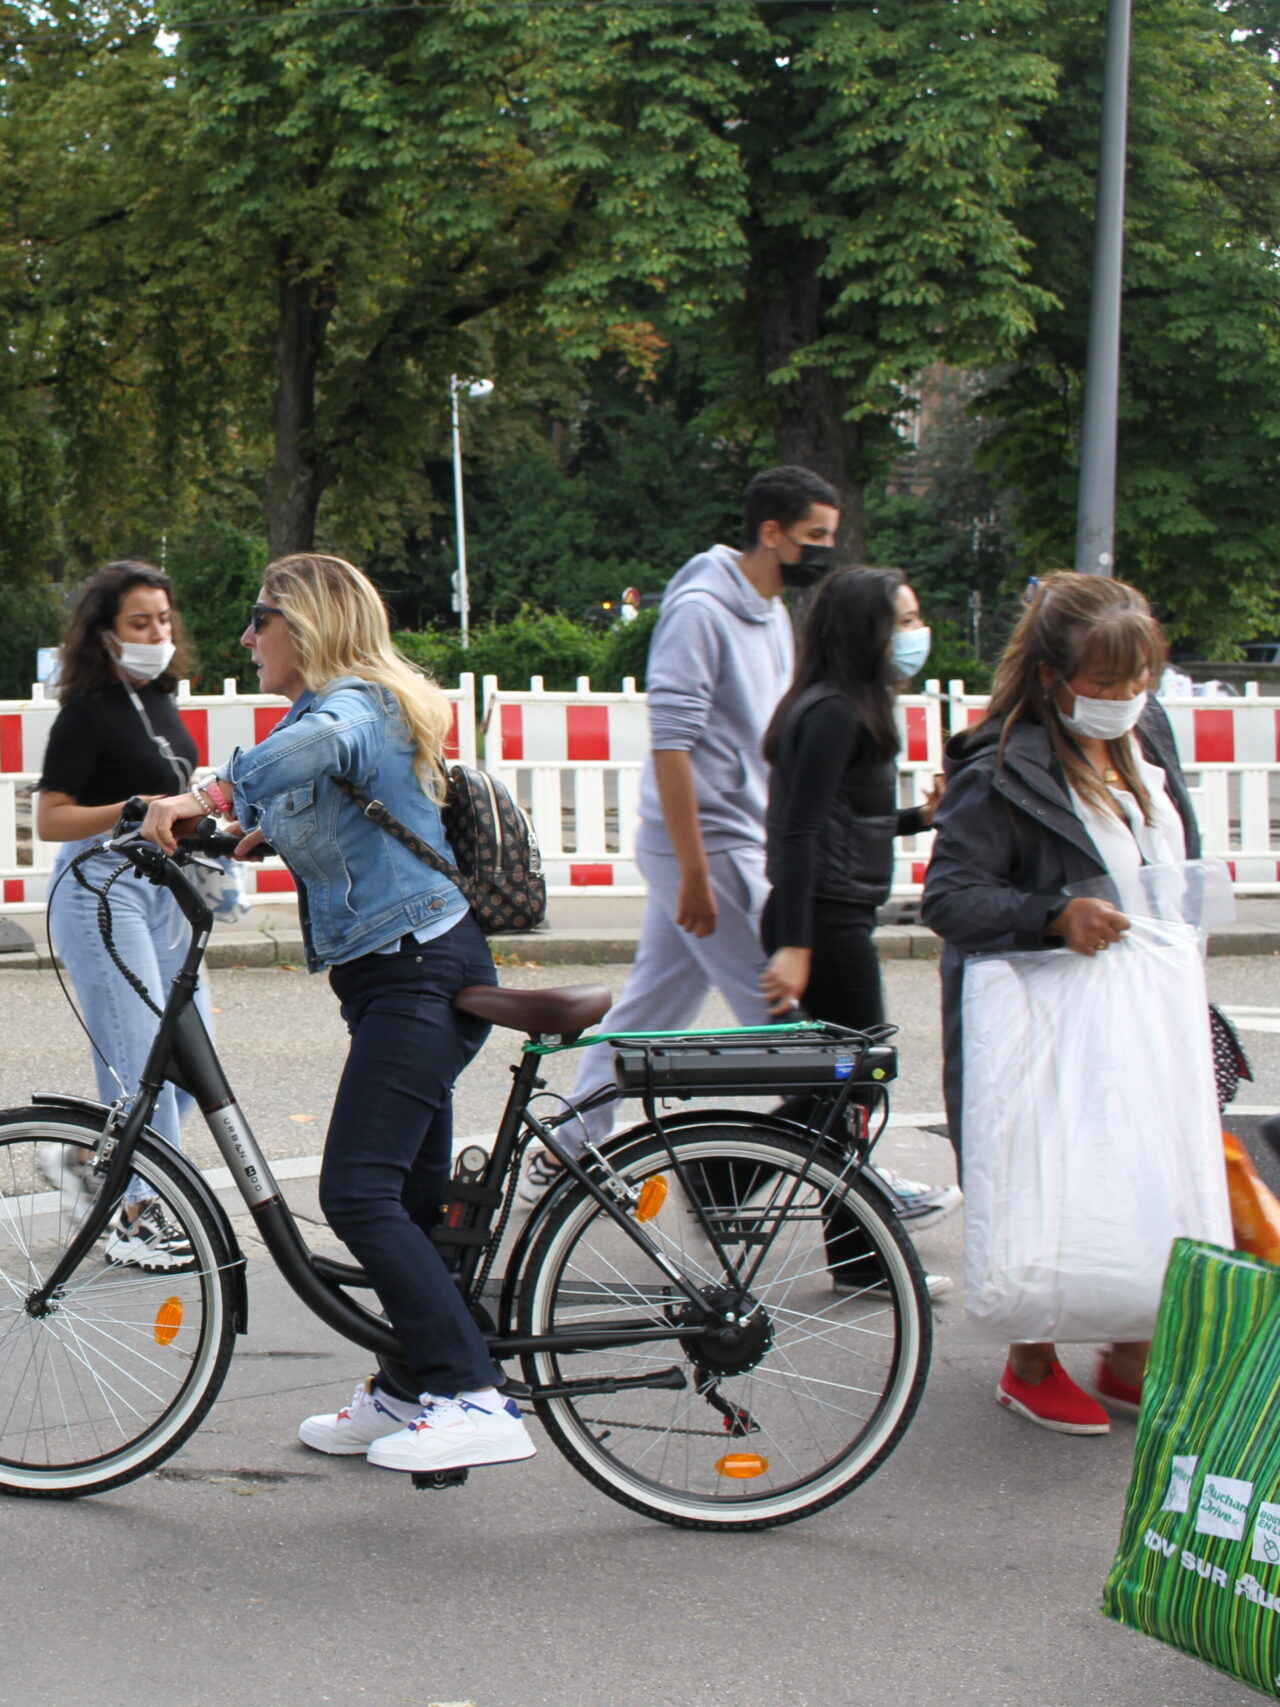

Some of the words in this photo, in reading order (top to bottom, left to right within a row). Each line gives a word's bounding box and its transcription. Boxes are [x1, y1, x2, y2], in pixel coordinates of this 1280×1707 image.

[223, 1117, 247, 1159] URBAN
[1204, 1482, 1248, 1514] Auchan
[1181, 1550, 1228, 1589] SUR
